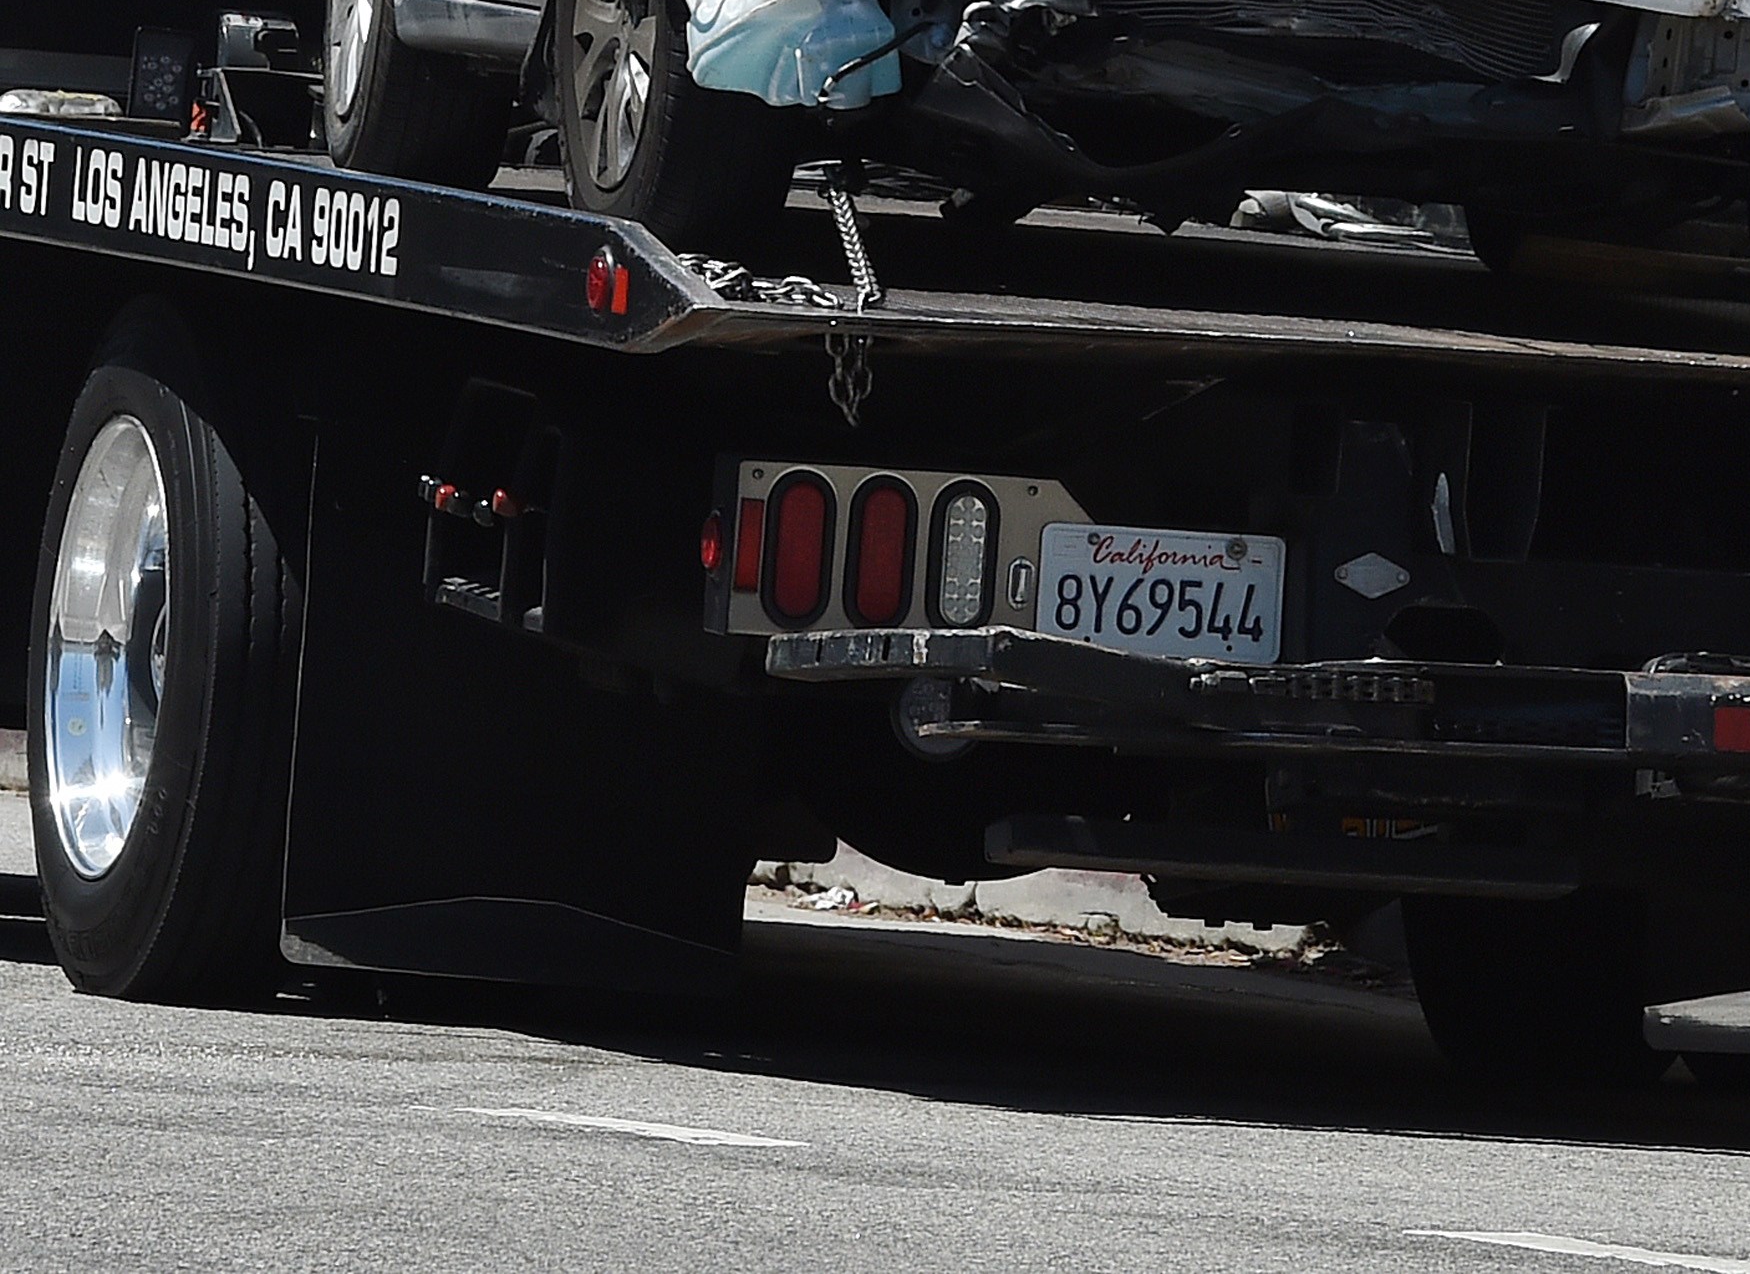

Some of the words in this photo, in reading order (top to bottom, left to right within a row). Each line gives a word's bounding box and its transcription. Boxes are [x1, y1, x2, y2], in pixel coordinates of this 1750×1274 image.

[19, 138, 56, 216] ST
[71, 145, 125, 228] LOS
[128, 157, 256, 271] ANGELES,
[265, 179, 302, 261] CA
[311, 186, 400, 276] 90012
[1093, 534, 1242, 575] California
[1054, 574, 1264, 643] 8Y69544
